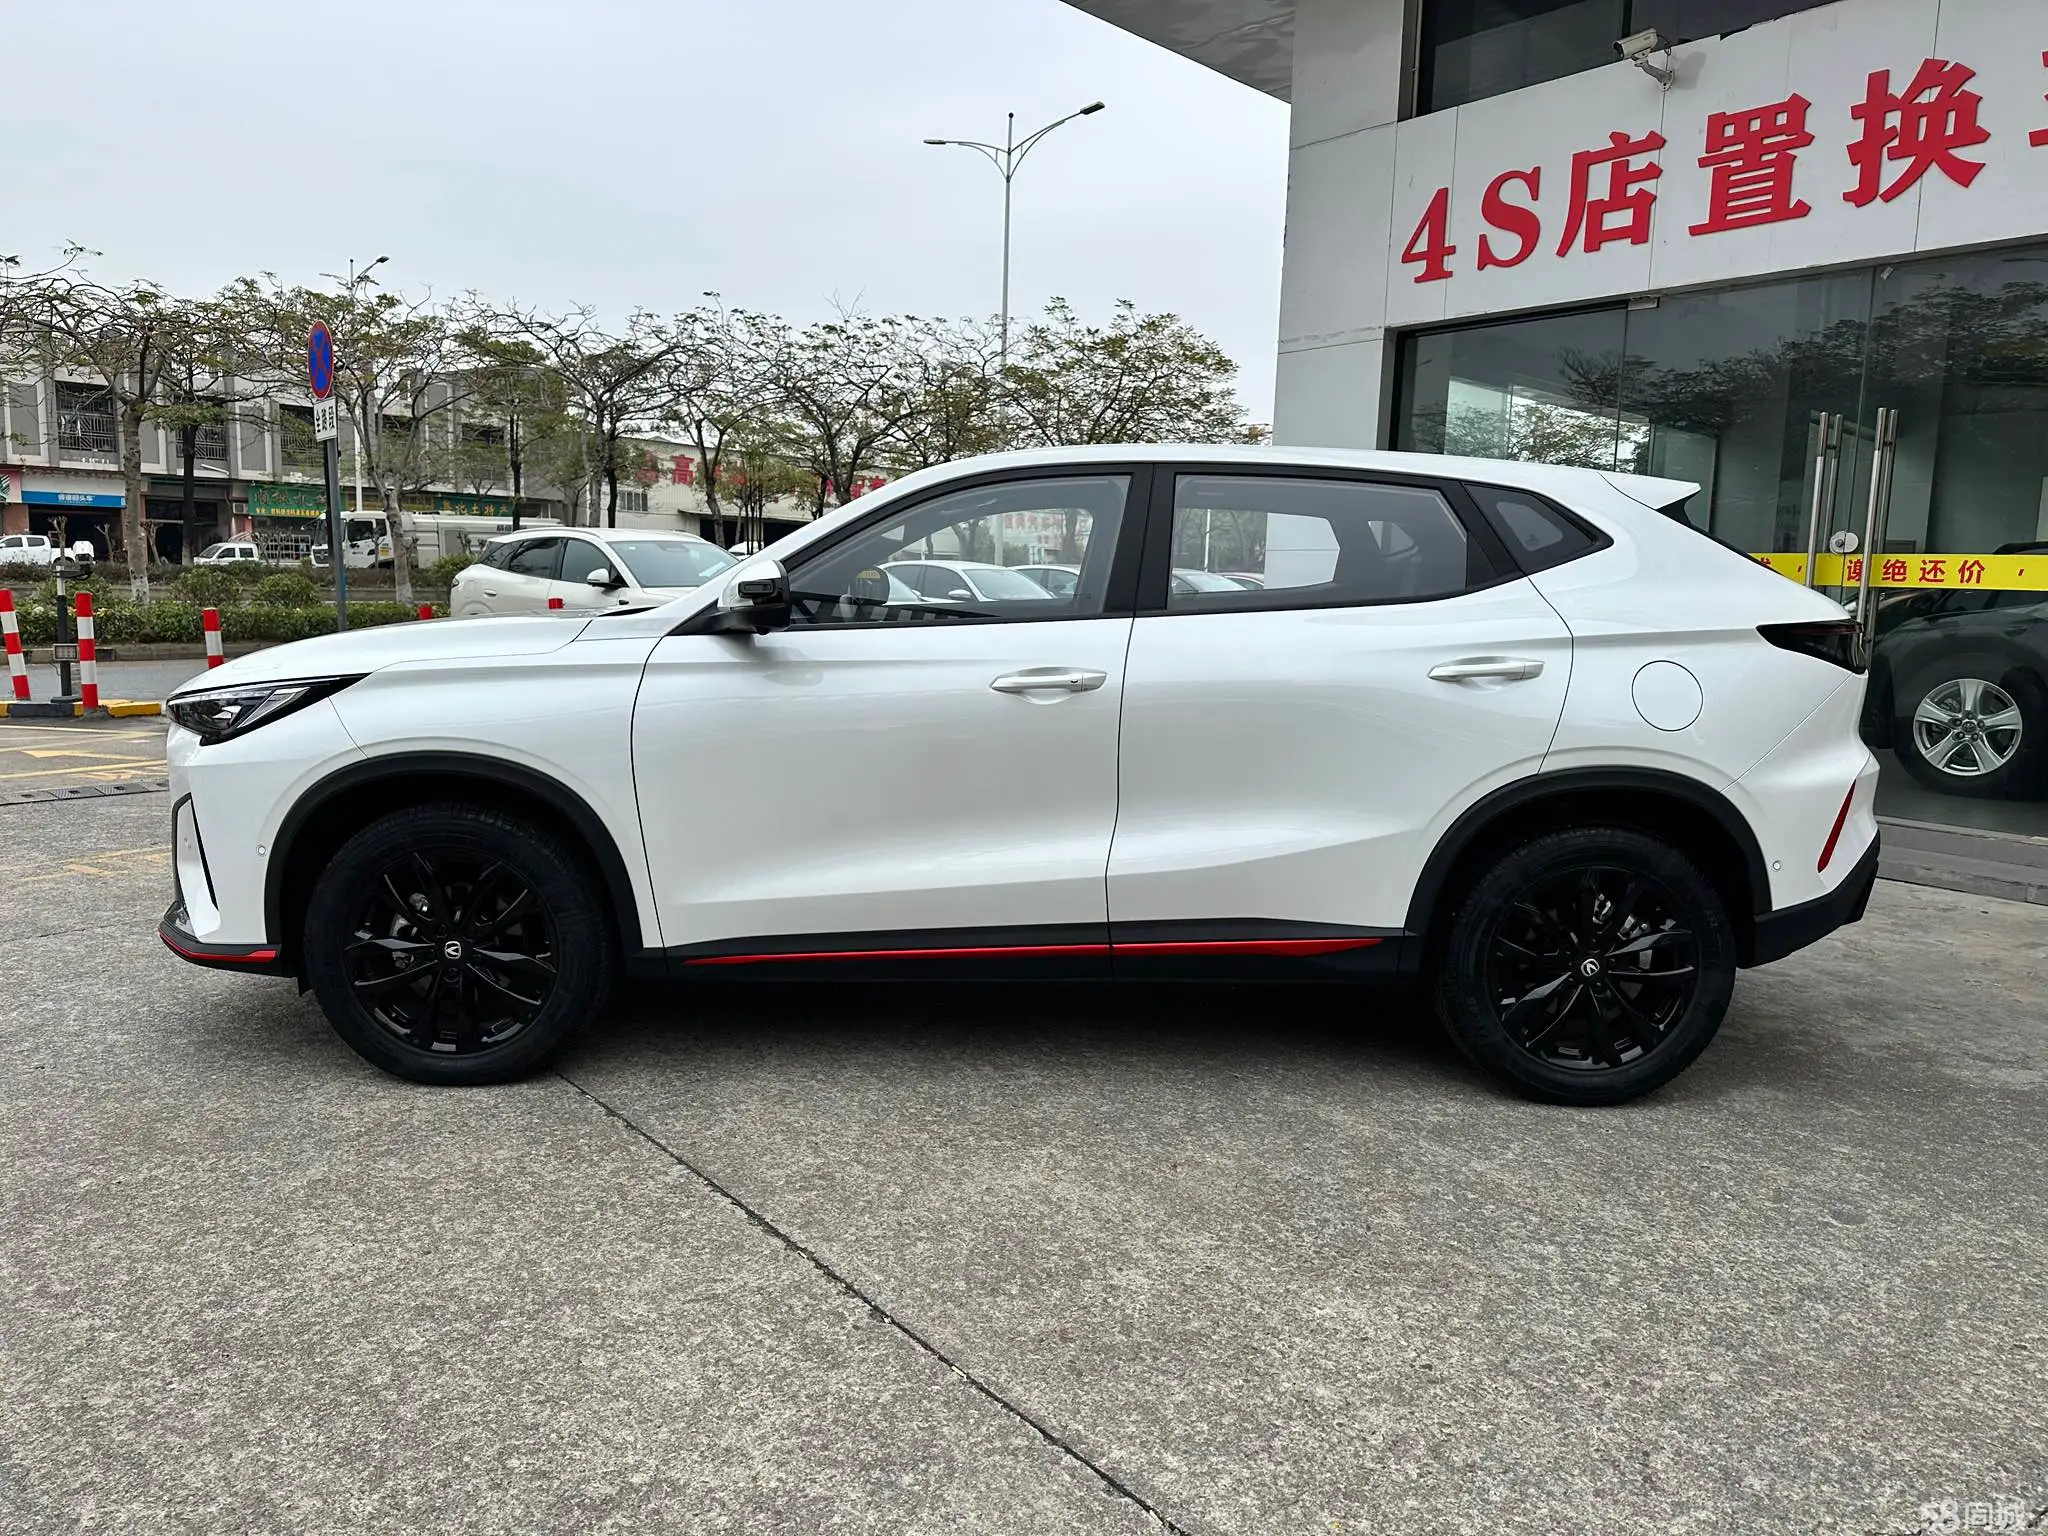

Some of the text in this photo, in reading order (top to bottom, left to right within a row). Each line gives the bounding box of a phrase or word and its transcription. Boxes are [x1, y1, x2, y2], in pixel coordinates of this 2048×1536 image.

[1401, 51, 2048, 284] 4S店置换
[315, 405, 335, 433] 全路段
[1846, 558, 1986, 585] 谢绝还价
